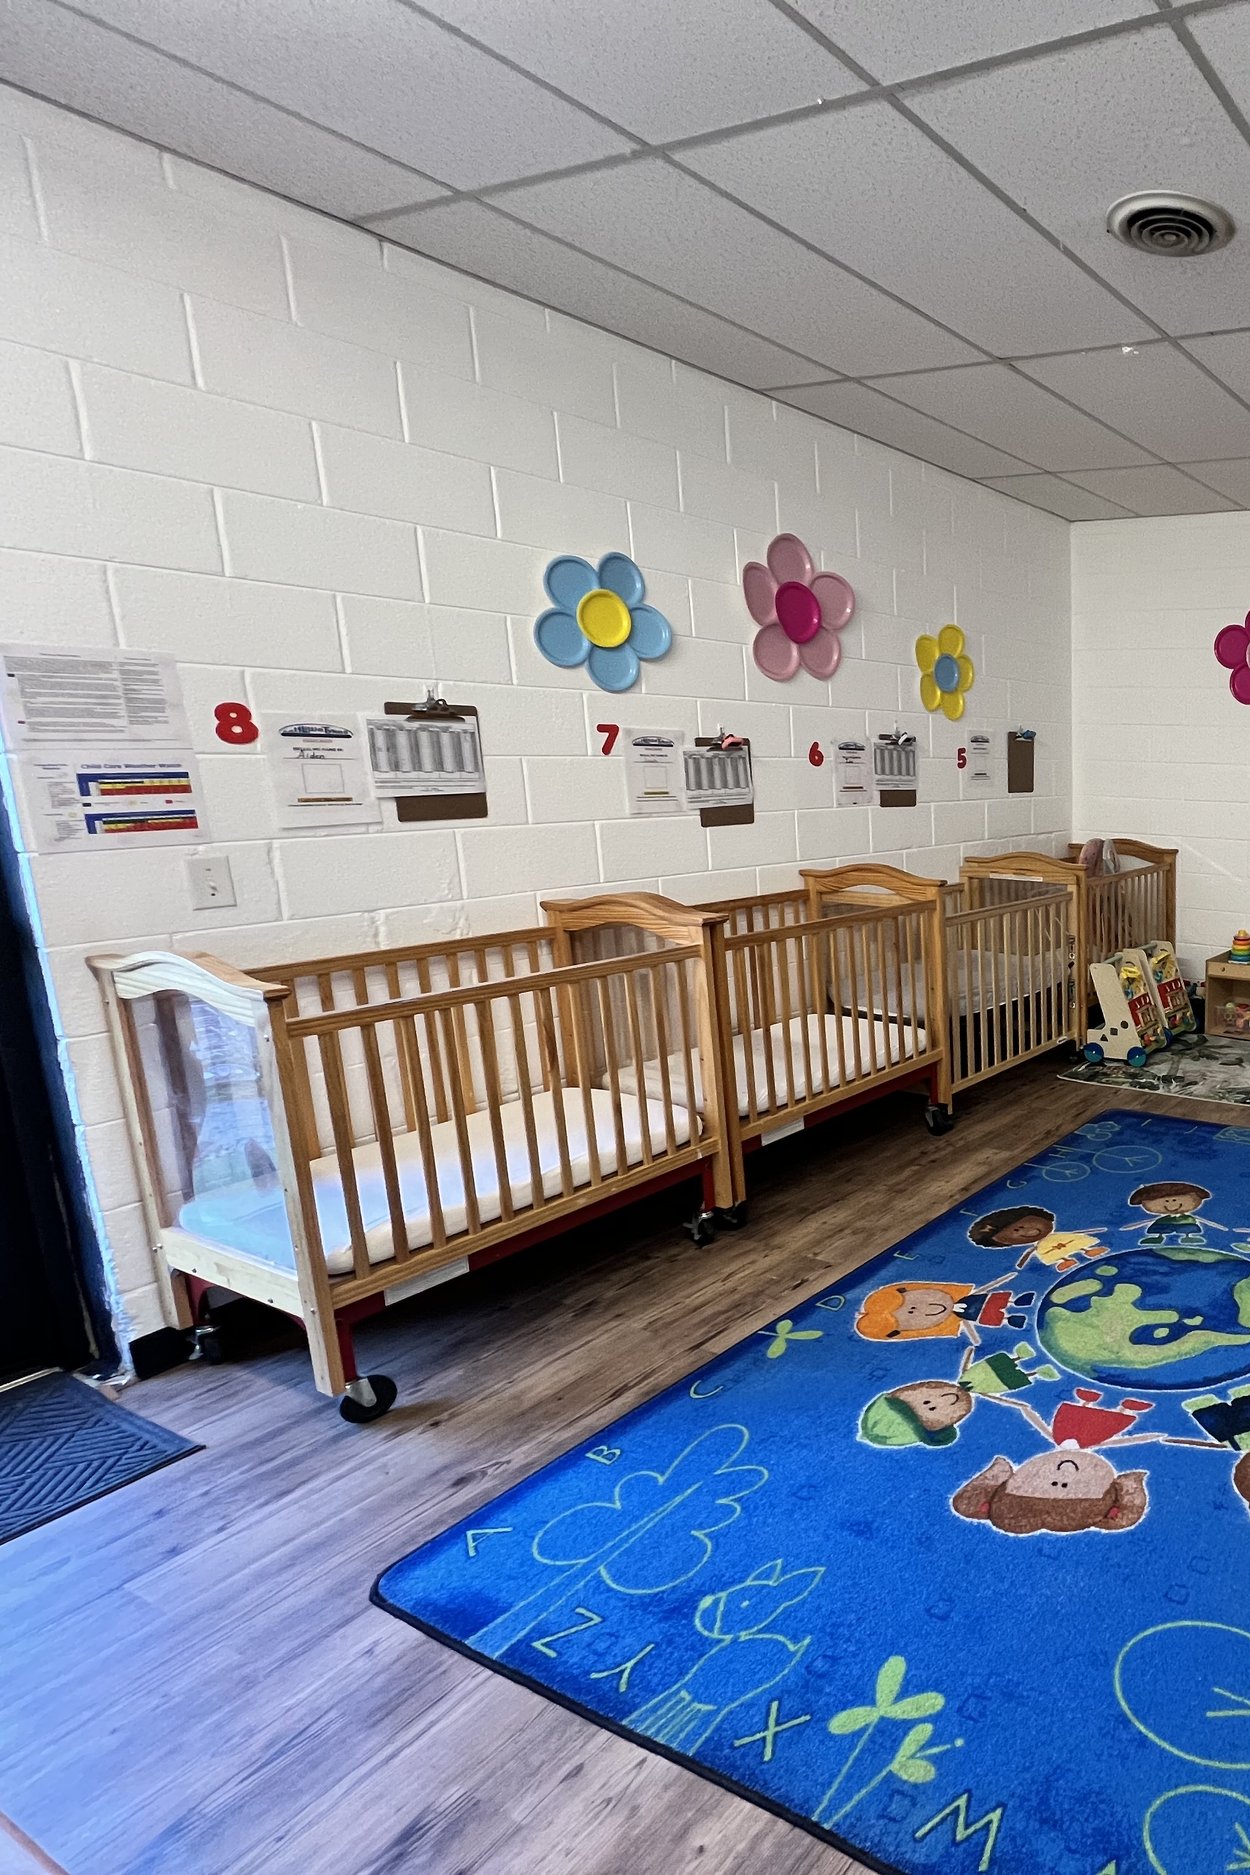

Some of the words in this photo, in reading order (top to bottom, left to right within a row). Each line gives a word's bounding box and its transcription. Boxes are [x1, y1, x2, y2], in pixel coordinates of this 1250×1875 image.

[214, 702, 259, 745] 8
[596, 724, 619, 756] 7
[809, 742, 824, 767] 6
[957, 748, 967, 769] 5
[466, 1527, 513, 1557] A
[584, 1445, 621, 1465] B
[689, 1380, 724, 1399] C
[815, 1295, 846, 1311] D
[893, 1250, 920, 1261] E
[532, 1607, 604, 1658] Z
[589, 1643, 655, 1693] Y
[733, 1700, 811, 1762] X
[914, 1793, 1003, 1872] W
